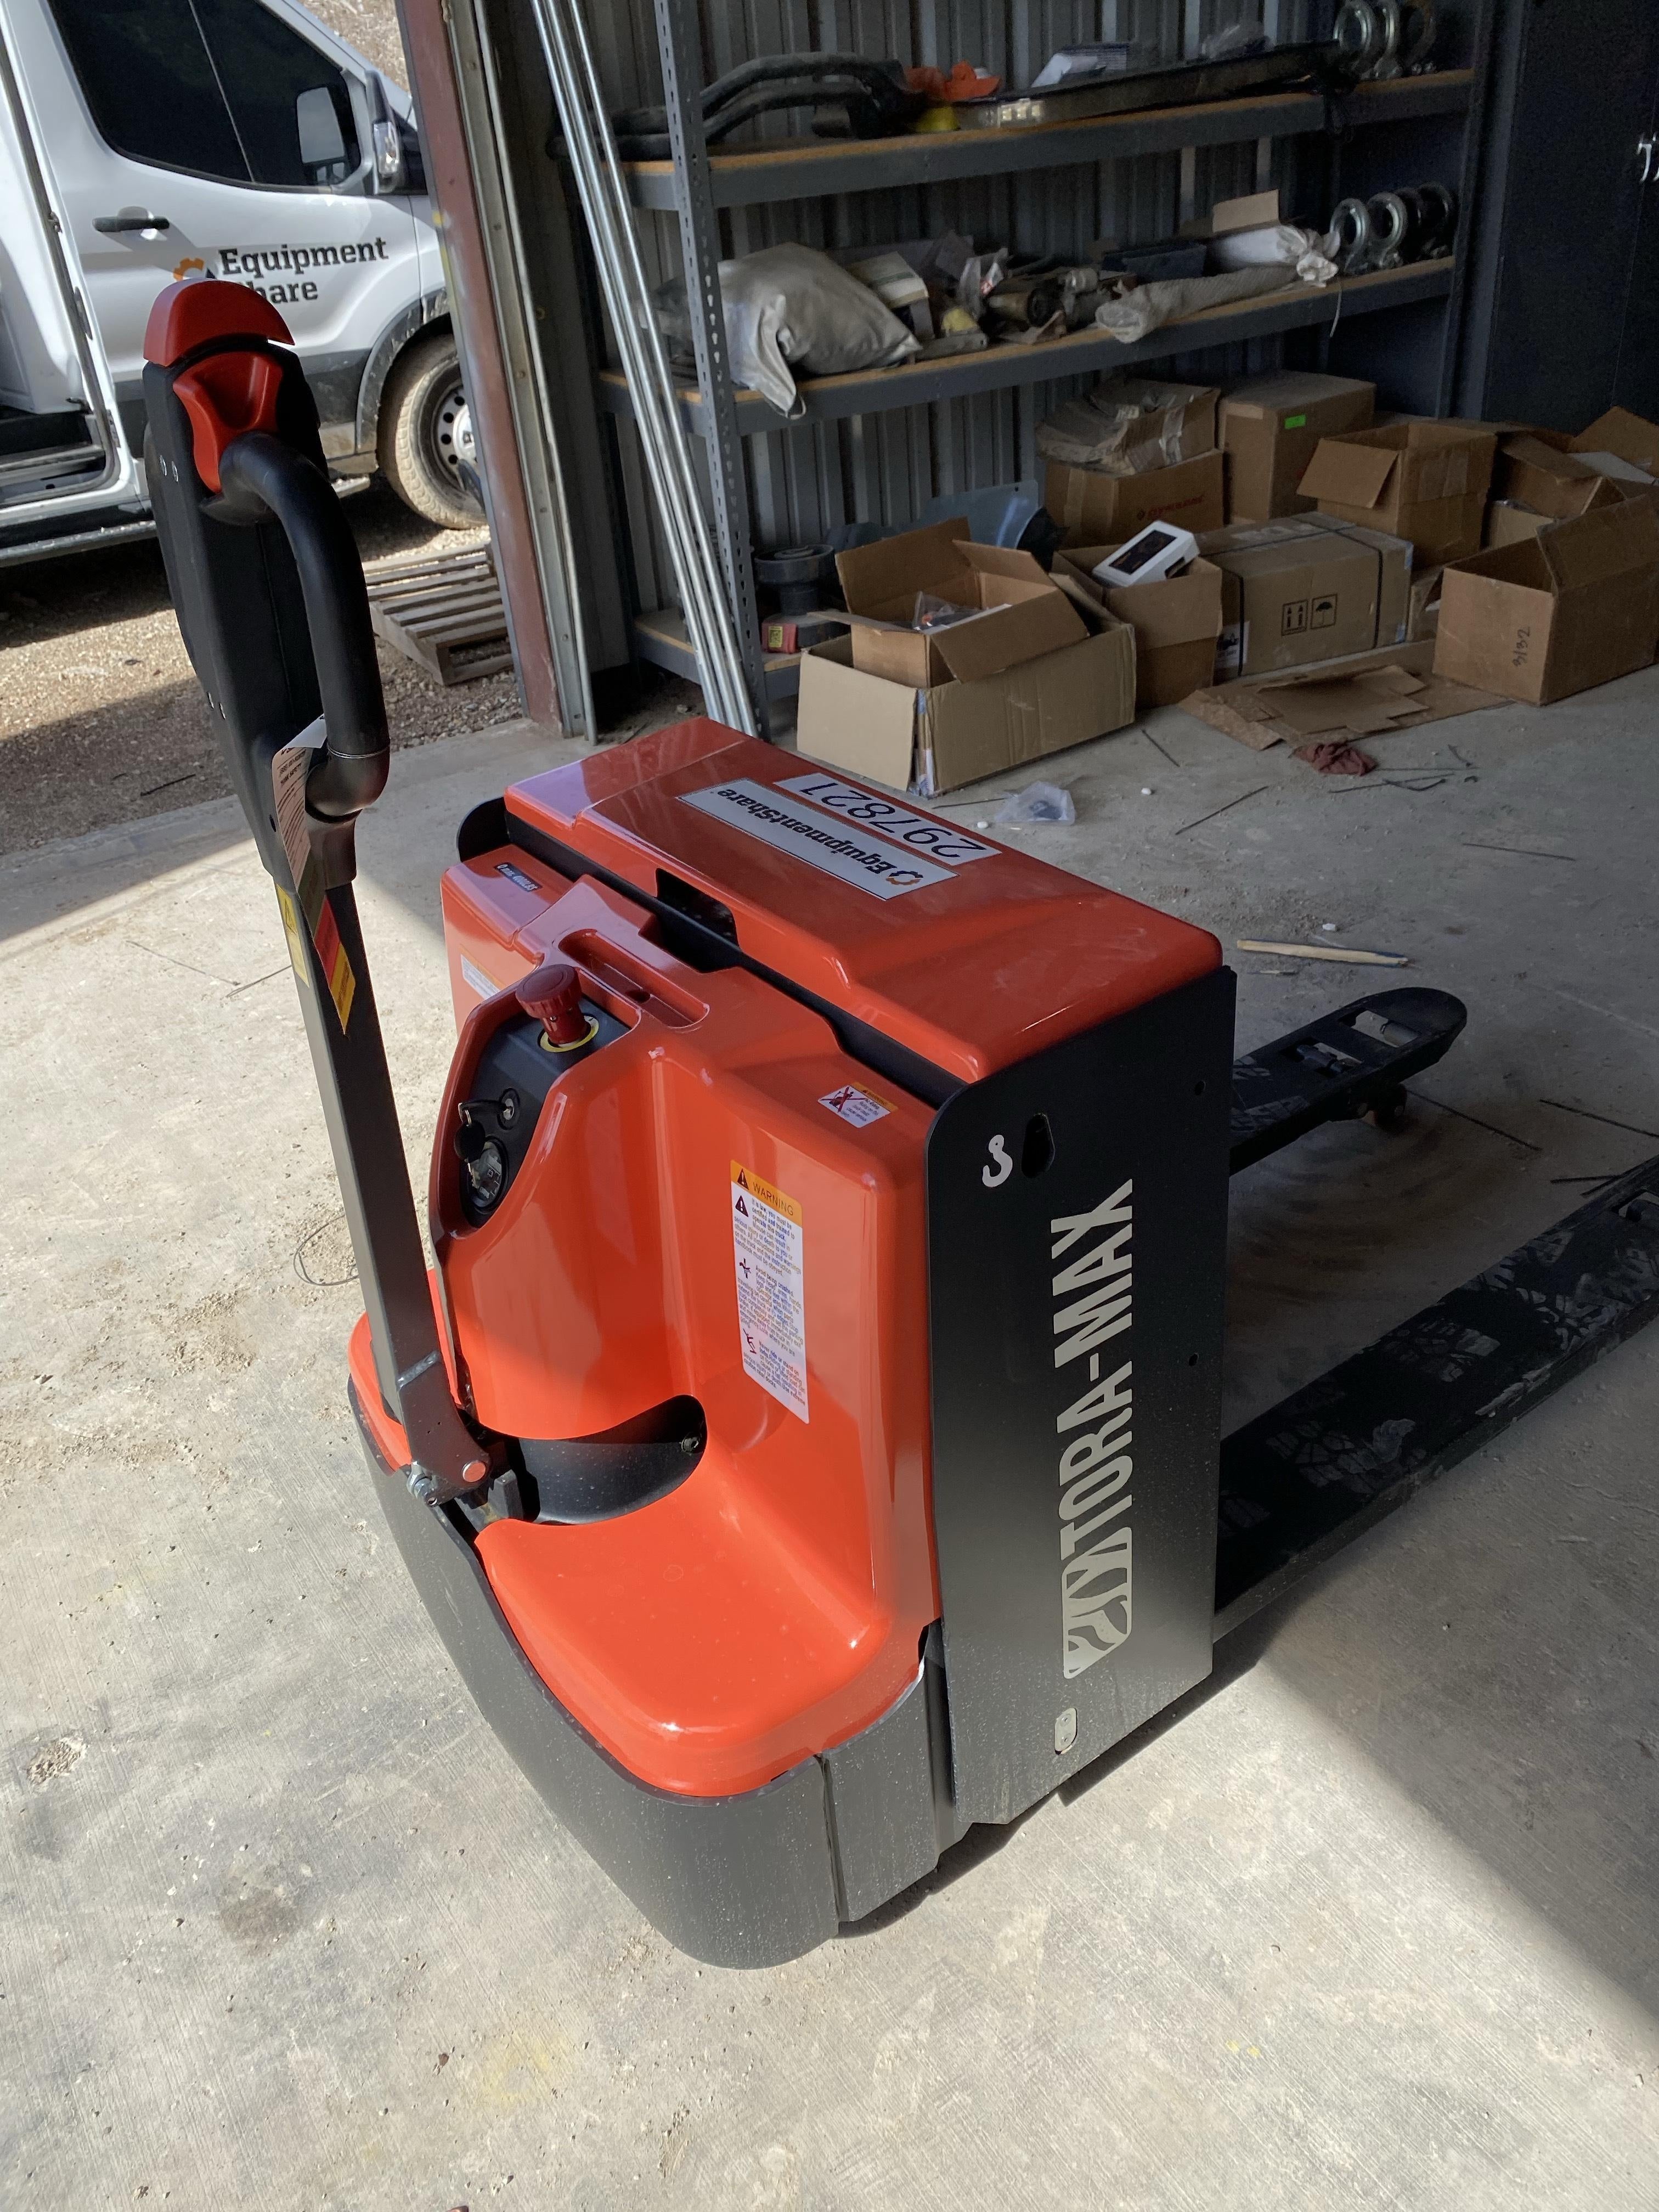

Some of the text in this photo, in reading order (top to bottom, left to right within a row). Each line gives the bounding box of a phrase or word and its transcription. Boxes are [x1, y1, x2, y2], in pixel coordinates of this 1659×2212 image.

[218, 237, 389, 279] Equipment
[239, 280, 318, 304] hare
[717, 788, 897, 874] EquipmentShare
[799, 782, 987, 858] 297821
[753, 1182, 794, 1216] WARNING
[1051, 1178, 1133, 1561] TORA-MAX
